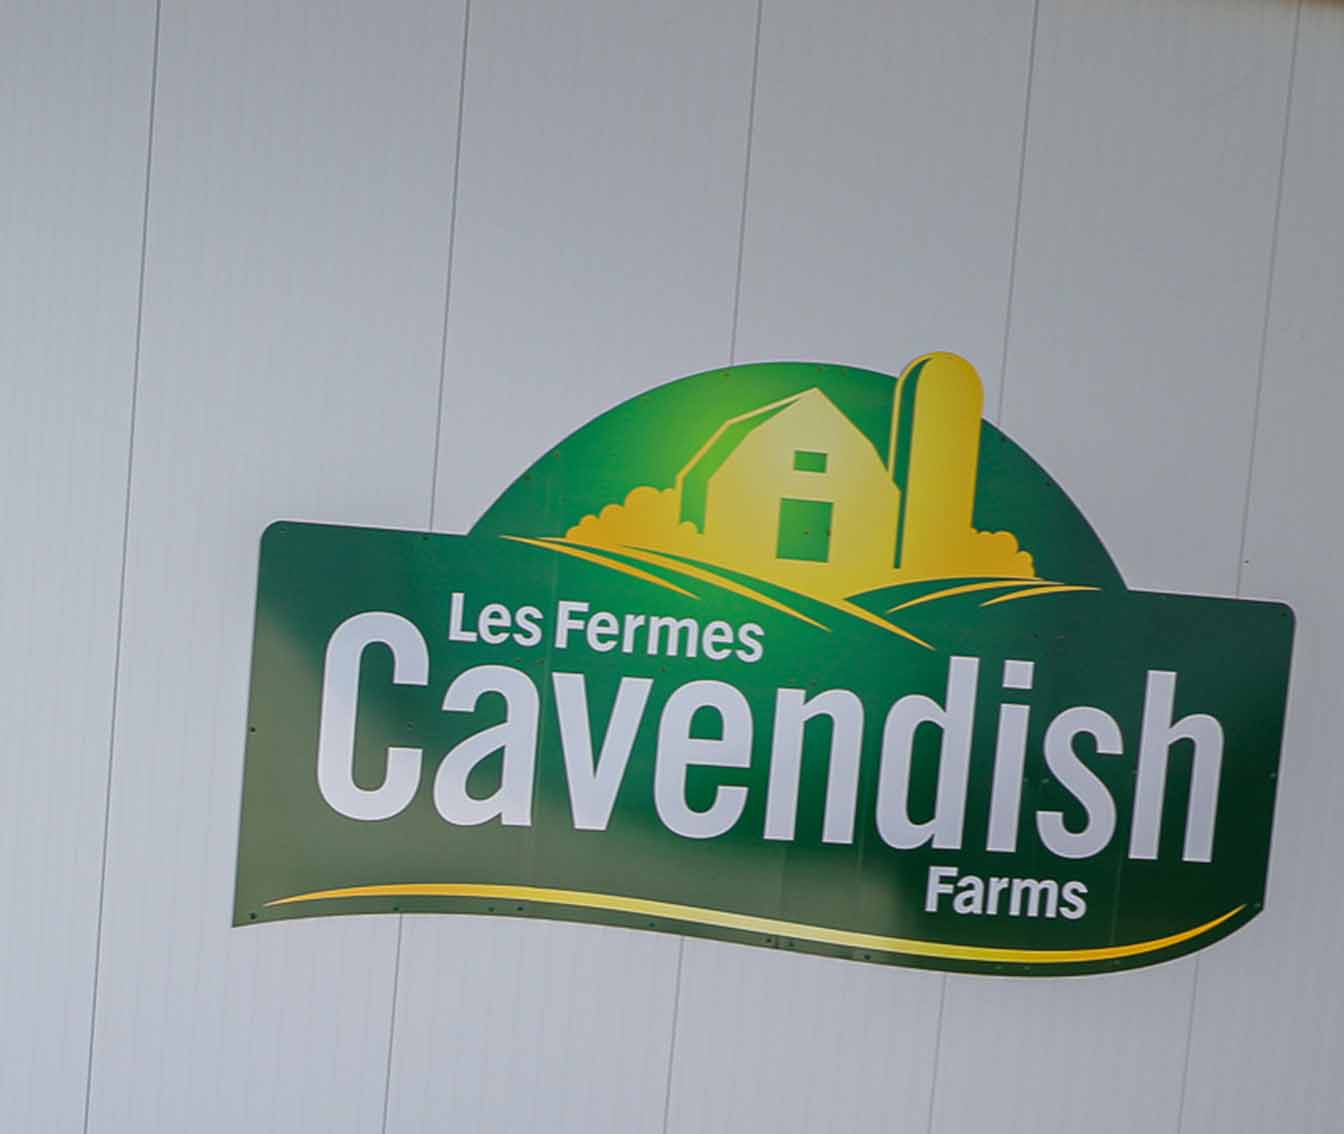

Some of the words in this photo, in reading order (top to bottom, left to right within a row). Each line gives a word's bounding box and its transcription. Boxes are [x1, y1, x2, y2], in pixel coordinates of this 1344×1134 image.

[448, 592, 543, 648] Les
[553, 600, 765, 664] Fermes
[315, 610, 1226, 864] Cavendish
[923, 866, 1088, 920] Farms
